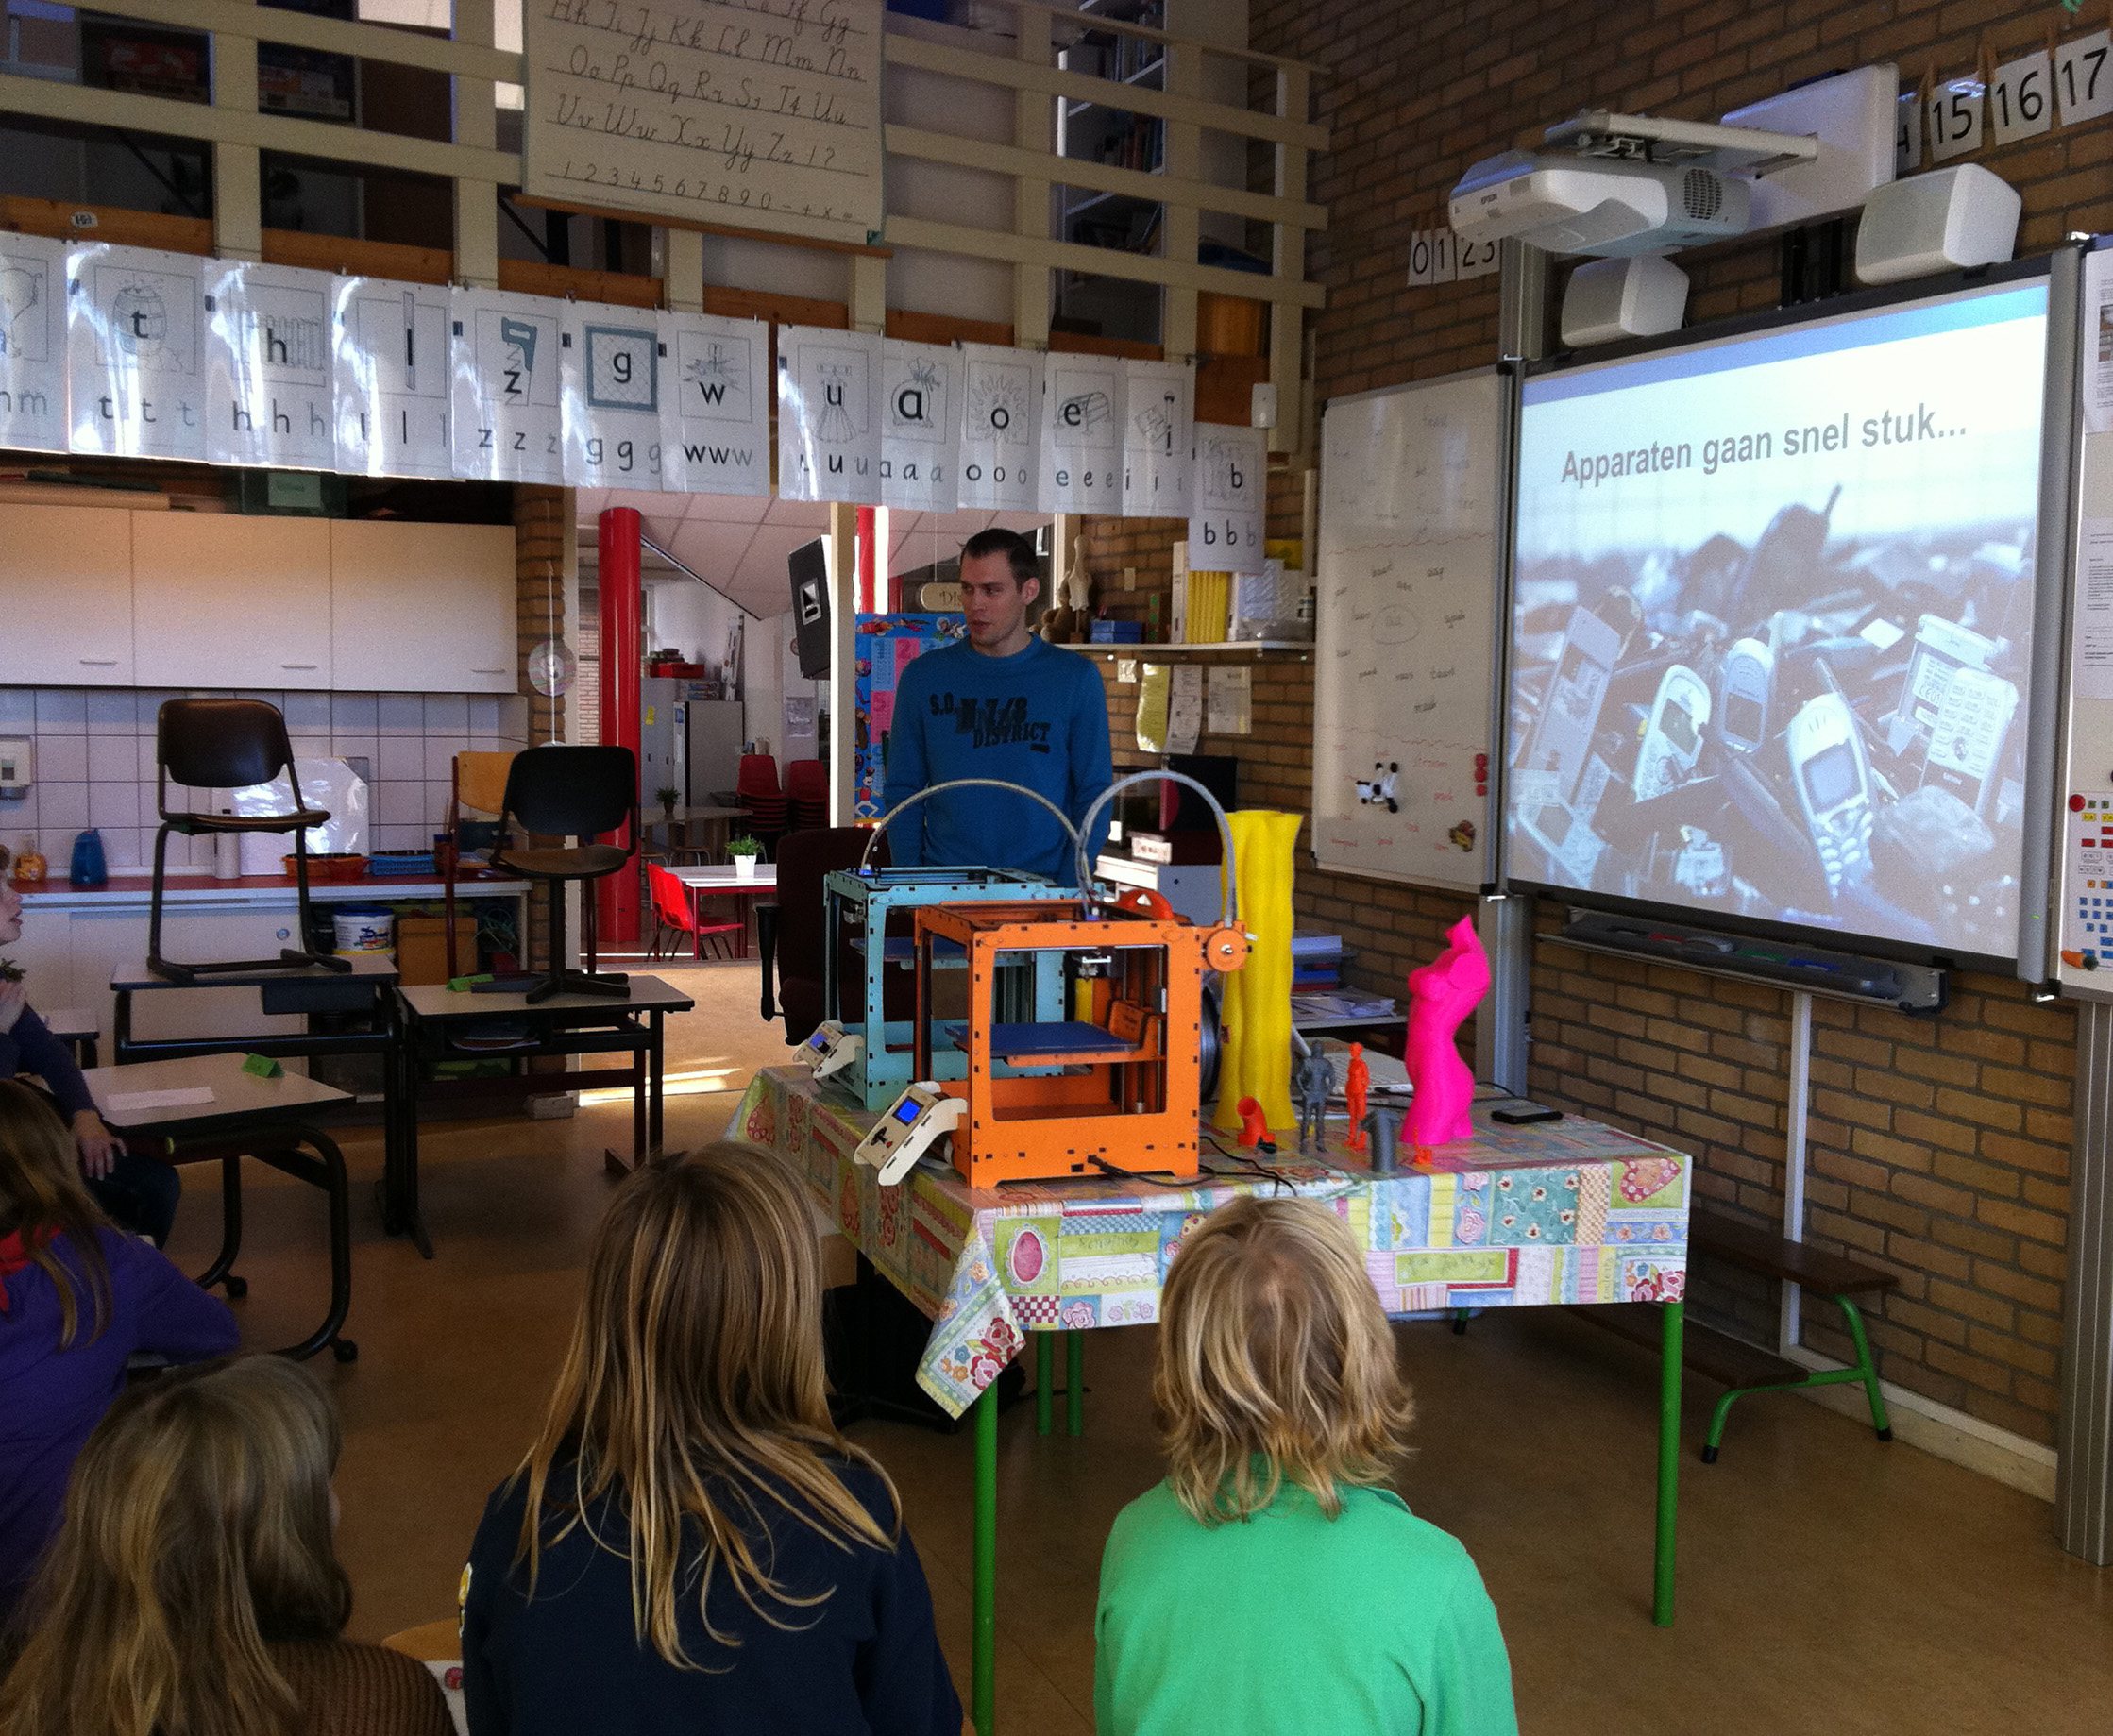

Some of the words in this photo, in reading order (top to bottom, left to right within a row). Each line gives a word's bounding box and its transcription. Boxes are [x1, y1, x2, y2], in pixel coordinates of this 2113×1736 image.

[1933, 92, 1973, 144] 15
[1990, 70, 2044, 127] 16
[2061, 47, 2109, 107] 17
[1561, 439, 1692, 489] Apparaten
[1703, 431, 1772, 476] gaan
[1783, 413, 1850, 457] snel
[1861, 402, 1968, 448] stuk...
